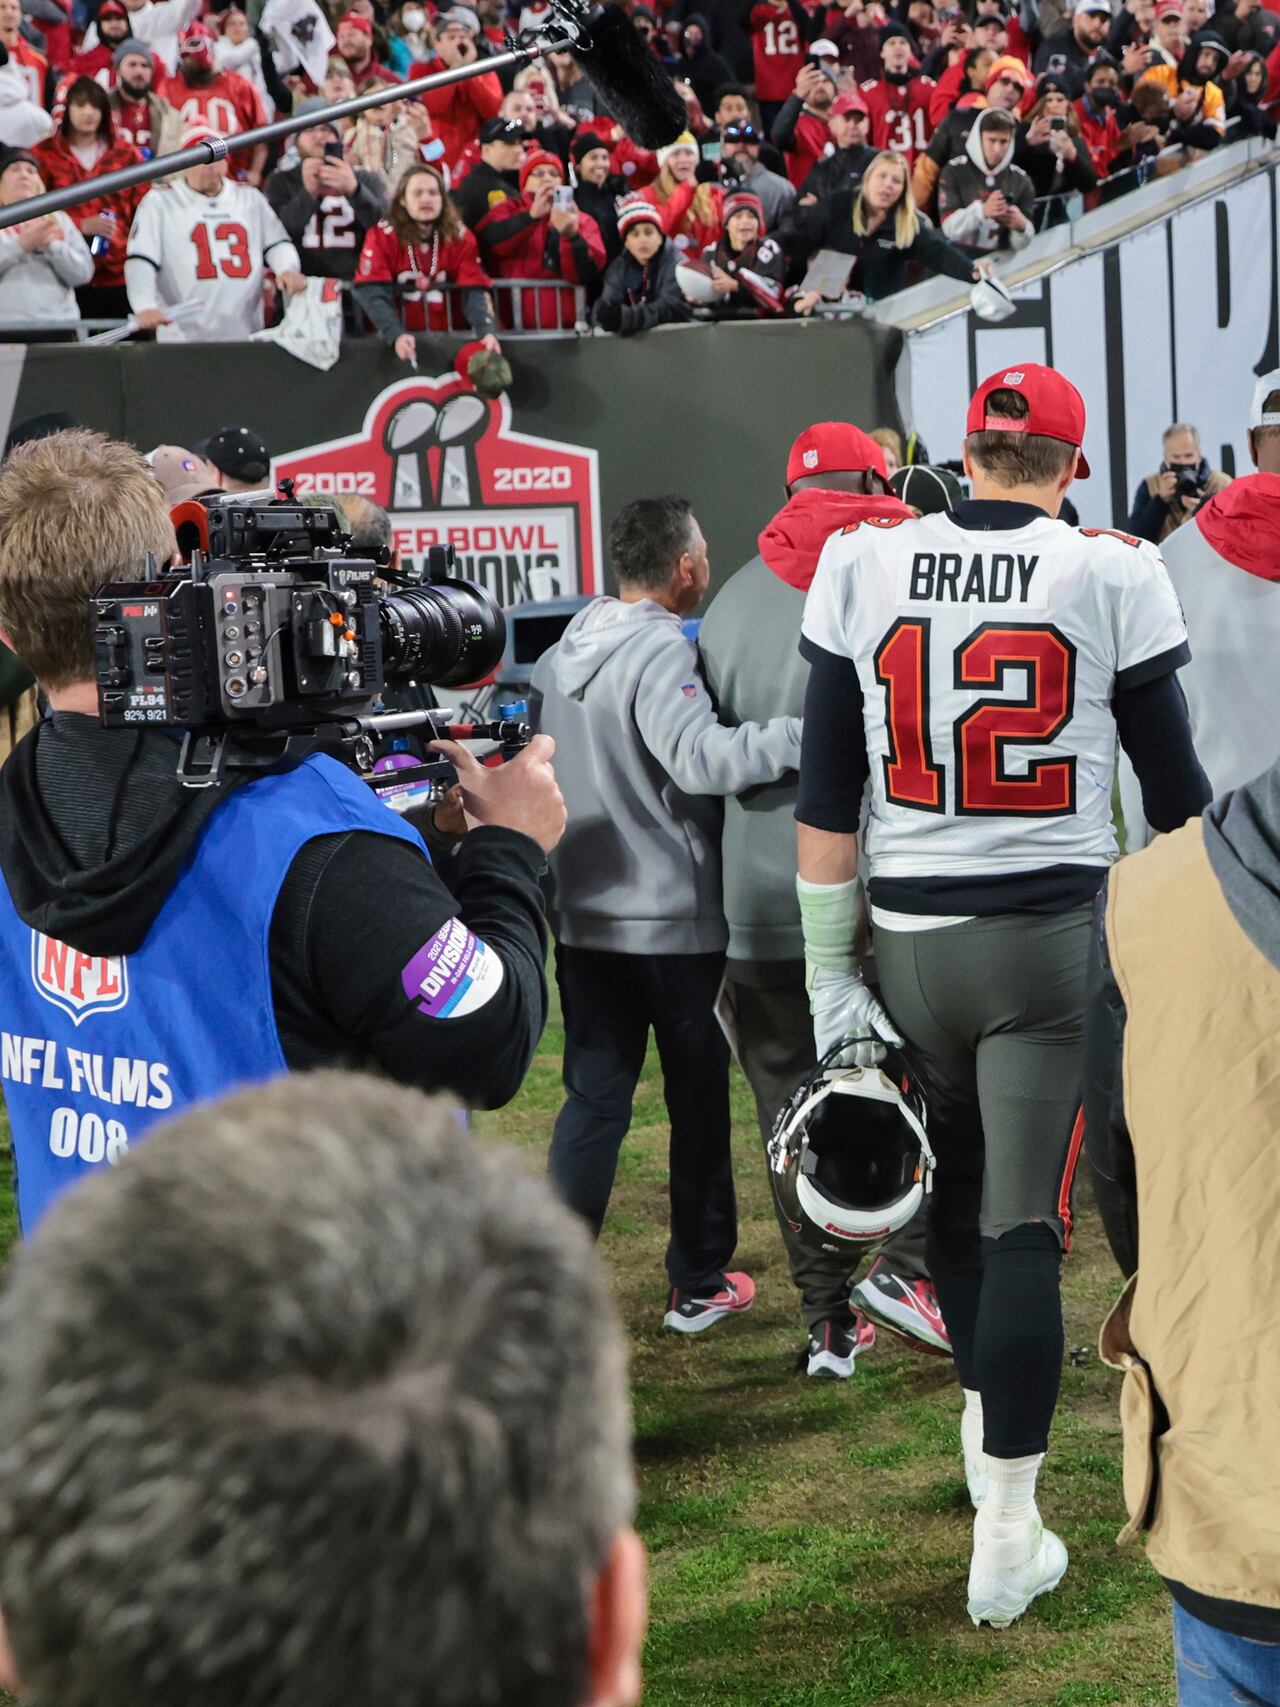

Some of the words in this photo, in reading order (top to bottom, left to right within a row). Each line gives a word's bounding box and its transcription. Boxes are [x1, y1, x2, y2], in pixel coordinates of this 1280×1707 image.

[764, 20, 798, 55] 12
[885, 107, 929, 151] 31
[302, 196, 356, 249] 12
[191, 222, 252, 280] 13
[295, 472, 377, 496] 2002
[493, 466, 573, 491] 2020
[449, 525, 559, 550] BOWL
[909, 553, 1039, 603] BRADY
[124, 710, 145, 721] 92%
[147, 709, 167, 720] 9/21
[873, 616, 1077, 818] 12
[41, 936, 119, 1001] NFL
[427, 940, 443, 961] 2021
[1, 1032, 64, 1090] NFL
[66, 1046, 174, 1110] FILMS
[50, 1106, 130, 1168] 008
